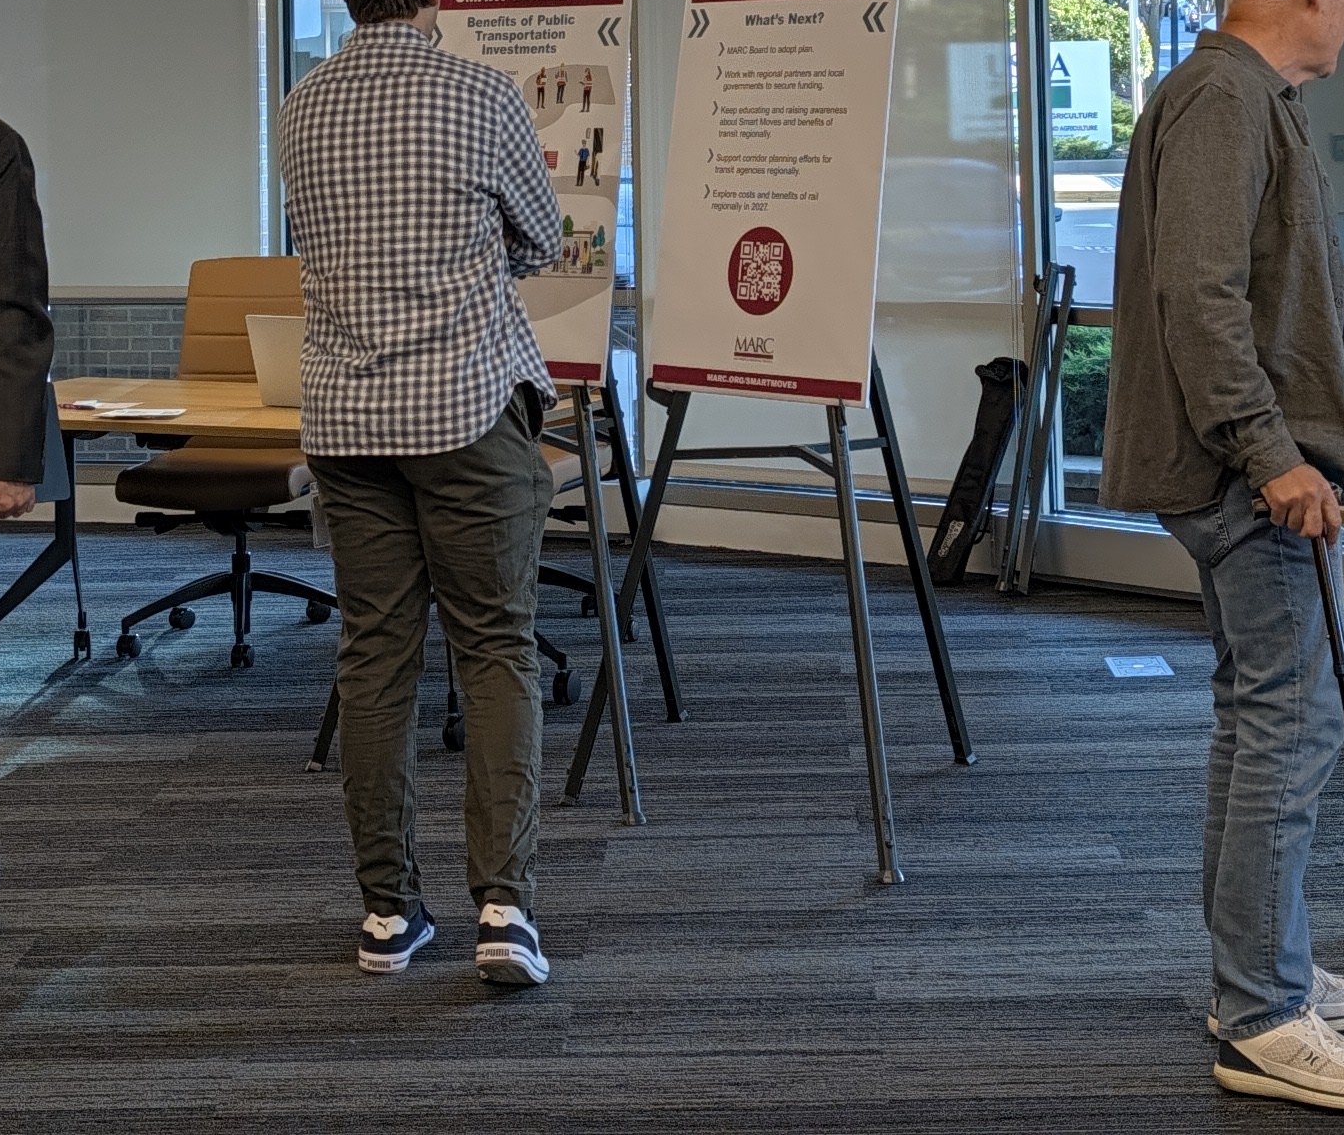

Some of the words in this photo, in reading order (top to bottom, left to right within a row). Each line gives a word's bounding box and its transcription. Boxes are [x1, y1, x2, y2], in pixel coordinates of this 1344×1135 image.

[467, 16, 516, 27] Benefits
[521, 15, 533, 26] of
[538, 14, 575, 25] Public
[745, 14, 784, 26] What's
[788, 12, 824, 24] Next?
[475, 29, 565, 43] Transportation
[482, 43, 557, 55] Investments
[727, 46, 748, 54] MARC
[749, 46, 768, 54] Board
[778, 45, 797, 55] adopt
[798, 45, 814, 54] plan.
[756, 70, 783, 79] regional
[784, 70, 811, 79] partners
[813, 69, 826, 77] and
[828, 69, 845, 77] local
[723, 82, 764, 92] governments
[797, 81, 824, 91] funding.
[721, 106, 737, 115] Keep
[739, 106, 770, 116] educating
[772, 106, 784, 114] and
[786, 106, 808, 116] raising
[798, 118, 824, 126] benefits
[826, 118, 833, 126] of
[716, 154, 741, 163] Support
[743, 154, 767, 162] corridor
[769, 154, 797, 165] planning
[799, 155, 820, 163] efforts
[822, 155, 832, 163] for
[736, 167, 765, 175] agencies
[713, 190, 737, 200] Explore
[738, 191, 755, 199] costs
[757, 191, 770, 199] and
[800, 192, 807, 200] of
[808, 193, 818, 201] rail
[711, 203, 742, 212] regionally
[735, 335, 774, 353] MARC
[485, 948, 510, 957] PUMA
[367, 959, 391, 969] PUMA
